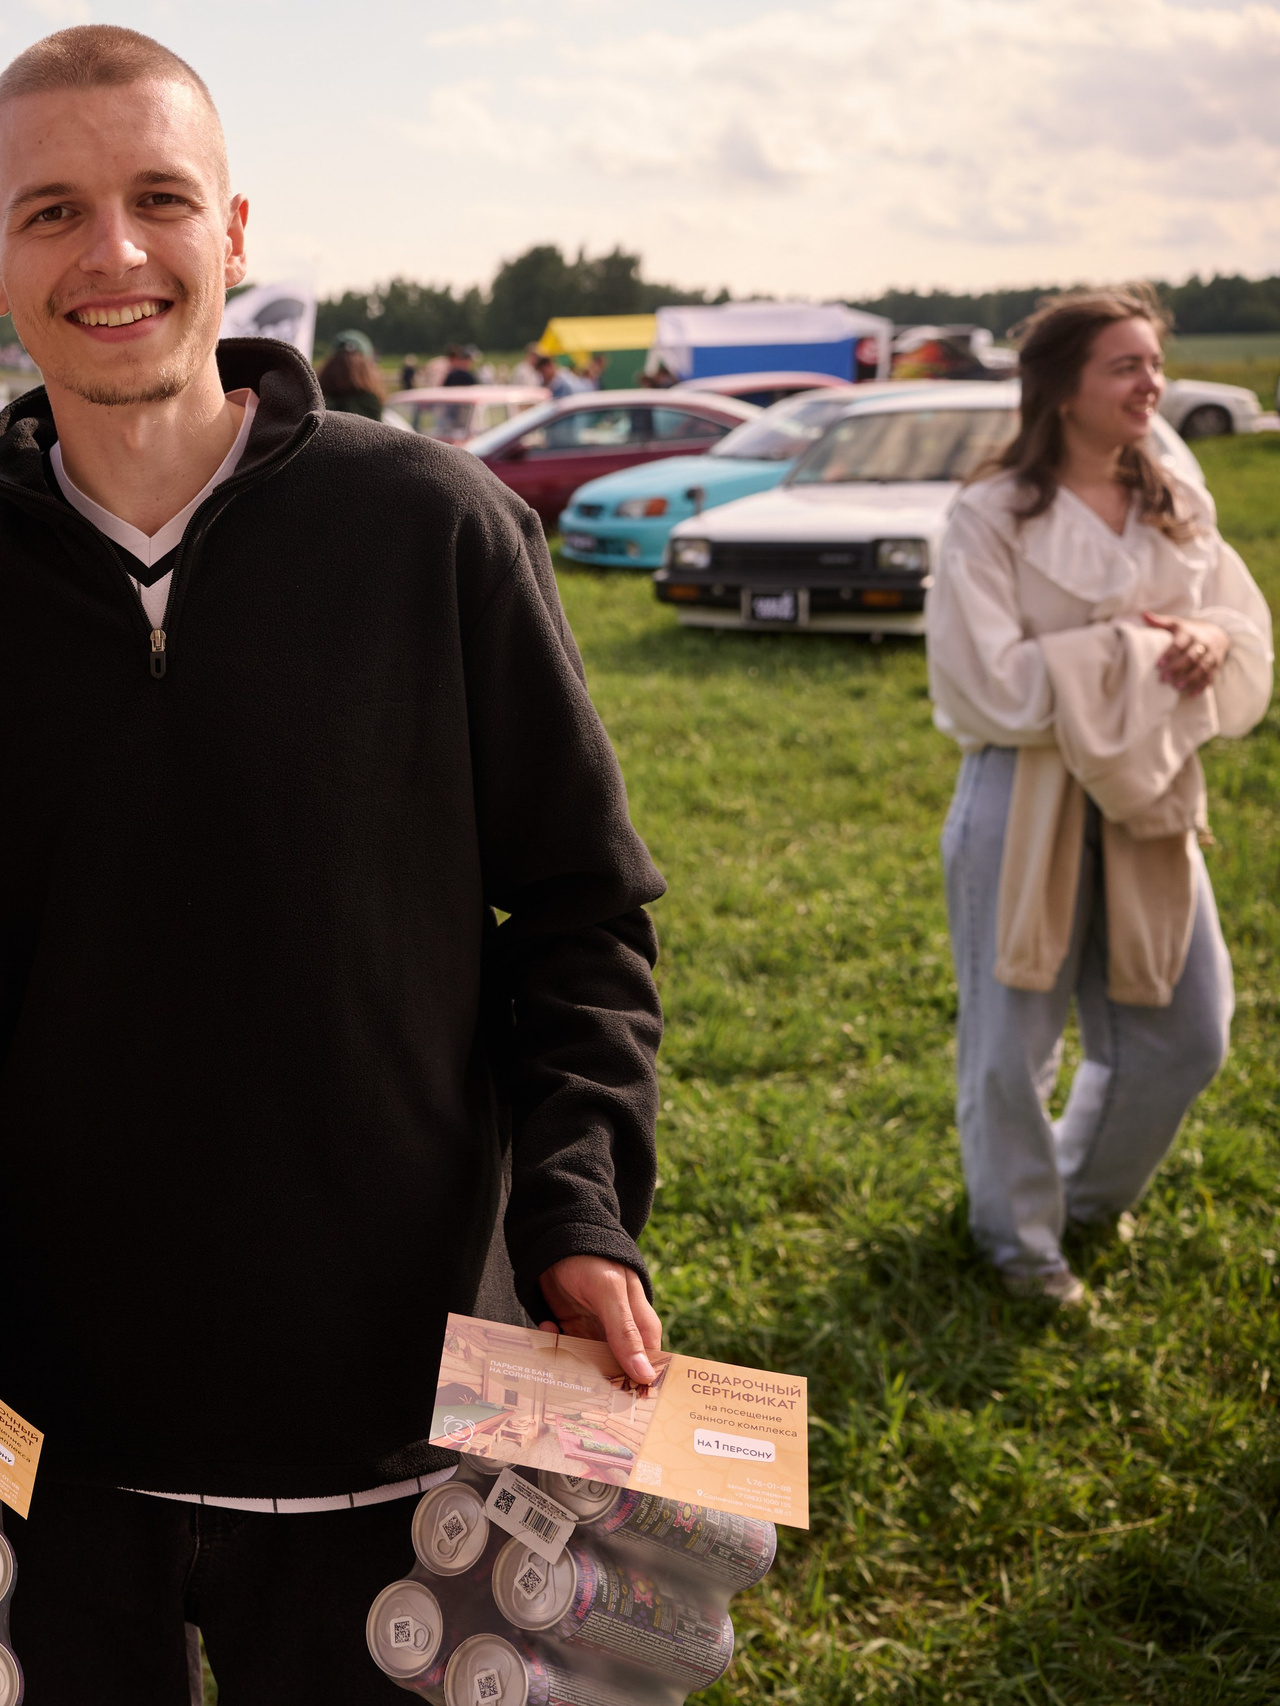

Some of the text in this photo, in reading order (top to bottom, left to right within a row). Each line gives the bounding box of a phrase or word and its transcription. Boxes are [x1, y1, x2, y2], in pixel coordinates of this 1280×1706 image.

[490, 1360, 523, 1372] ПАРЬСЯ
[531, 1368, 554, 1378] БАНЕ
[502, 1368, 557, 1385] СОЛНЕЧНОЙ
[556, 1380, 592, 1393] ПОЛЯНЕ
[685, 1368, 801, 1398] ПОДАРОЧНЫЙ
[690, 1382, 796, 1411] СЕРТИФИКАТ
[688, 1411, 797, 1439] банного комплекса
[704, 1403, 782, 1424] на посещение
[452, 1422, 463, 1432] 2
[696, 1438, 771, 1460] НА 1 ПЕРСОНУ
